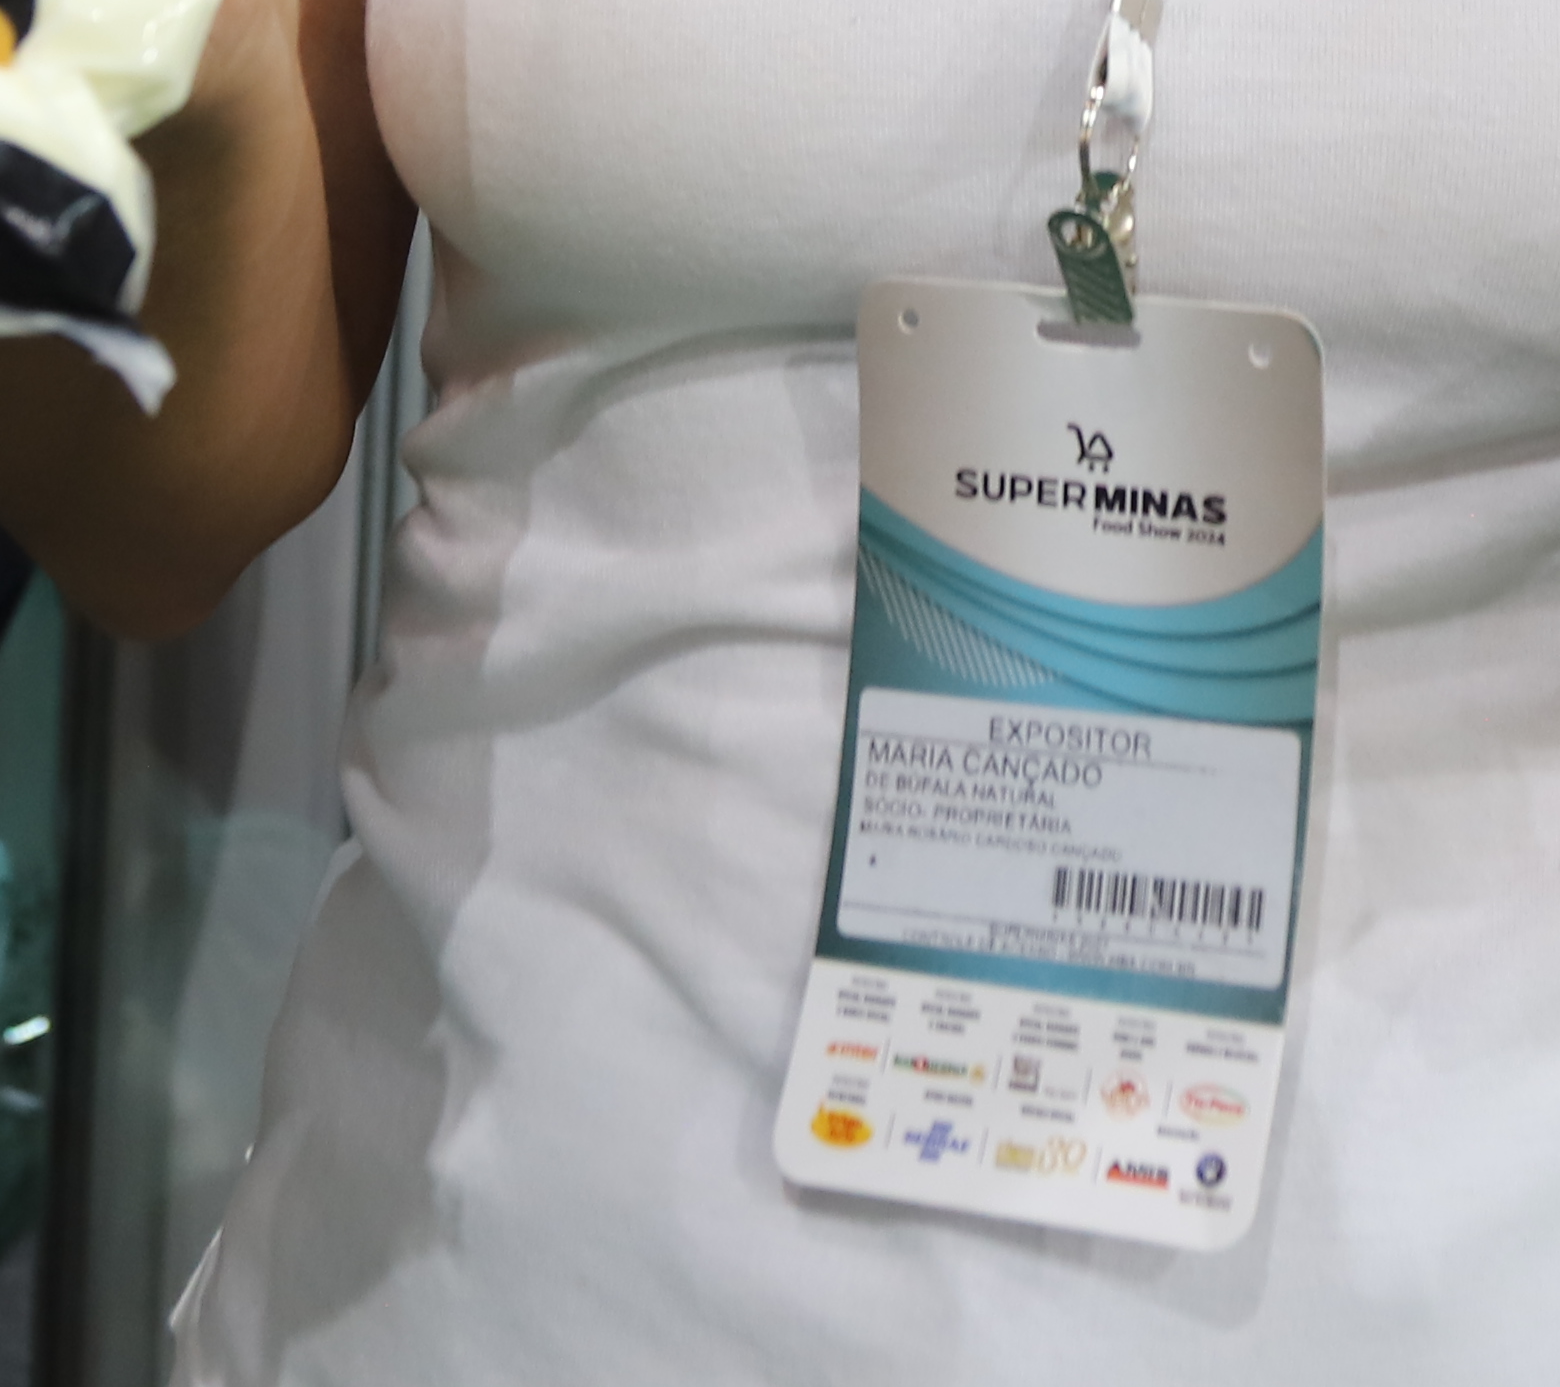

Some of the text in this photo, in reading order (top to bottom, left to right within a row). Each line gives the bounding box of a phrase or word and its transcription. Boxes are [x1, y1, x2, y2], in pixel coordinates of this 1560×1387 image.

[1093, 517, 1226, 547] Food Show 2024
[989, 716, 1152, 759] EXPOSITOR
[868, 738, 1102, 789] MARIA CANÇADO
[865, 770, 888, 788] DE
[972, 782, 1056, 809] NATURAL
